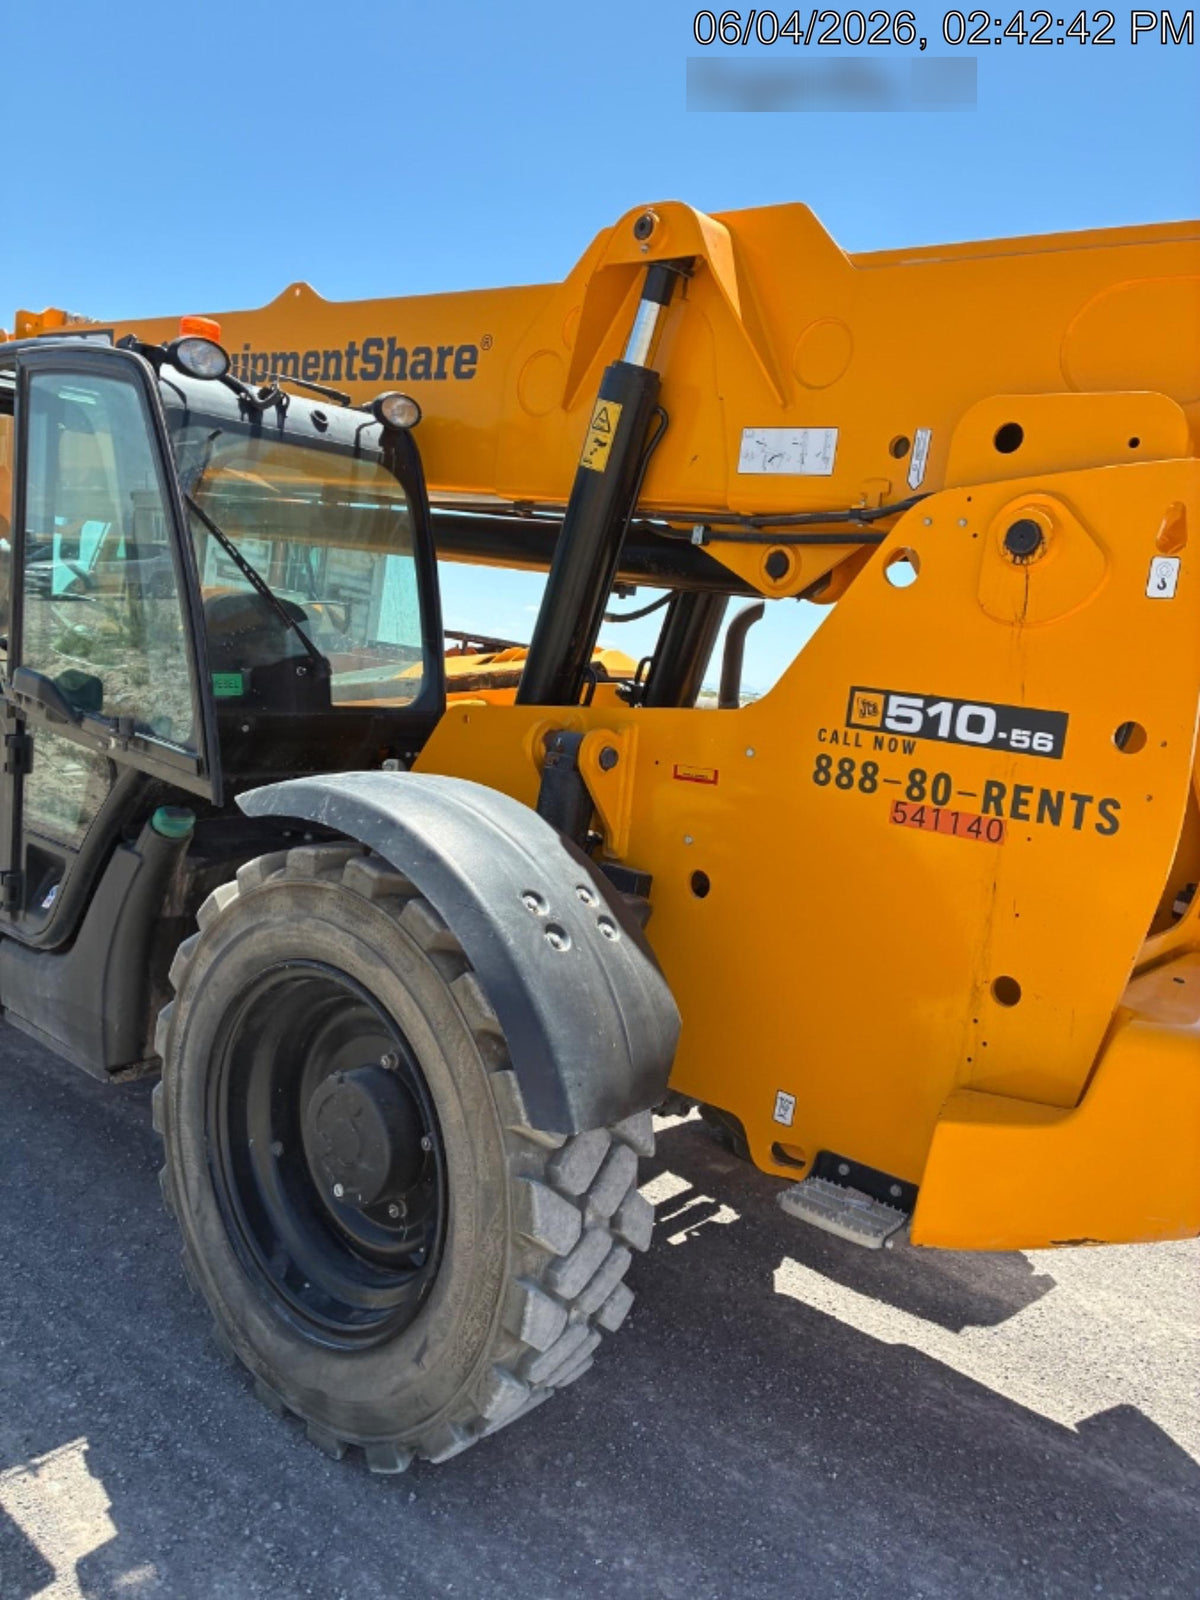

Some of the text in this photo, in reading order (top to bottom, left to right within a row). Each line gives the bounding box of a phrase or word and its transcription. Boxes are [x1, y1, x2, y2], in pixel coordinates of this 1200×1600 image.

[817, 728, 917, 756] CALL NOW
[884, 694, 1054, 753] 510-56
[812, 753, 1122, 836] 888-80-RENTS
[892, 801, 1004, 842] 541140
